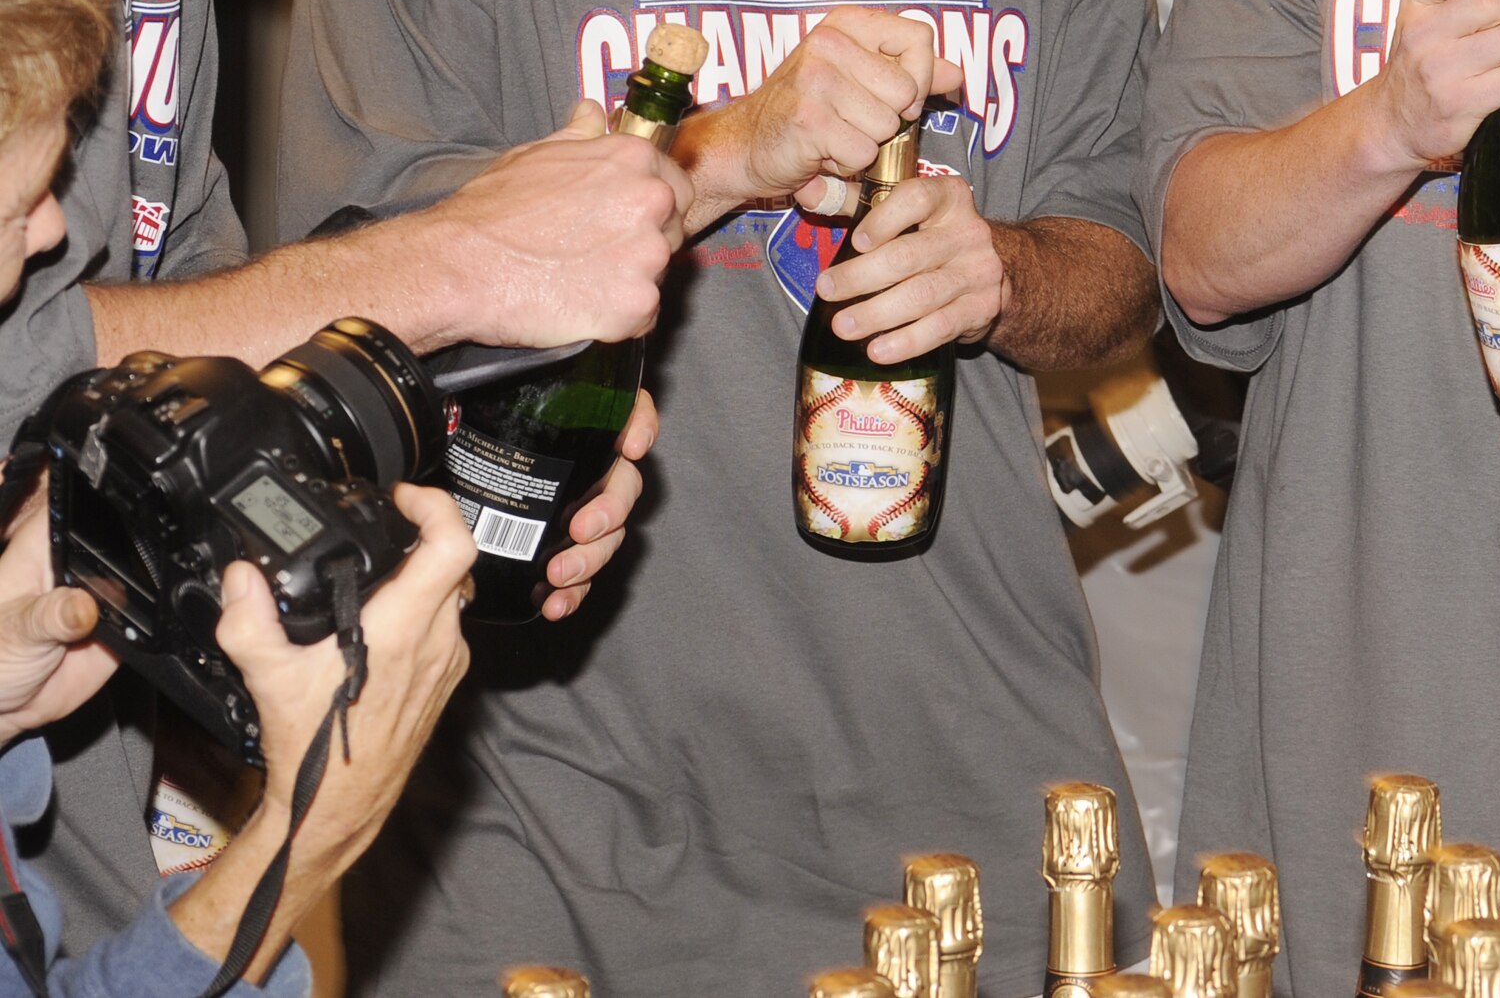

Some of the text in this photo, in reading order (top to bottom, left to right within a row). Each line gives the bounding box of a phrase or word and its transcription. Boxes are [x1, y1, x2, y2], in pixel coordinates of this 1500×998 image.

[836, 408, 897, 434] Phillies
[858, 442, 869, 450] TO
[816, 467, 910, 489] POSTSEASON
[151, 823, 213, 849] SEASON
